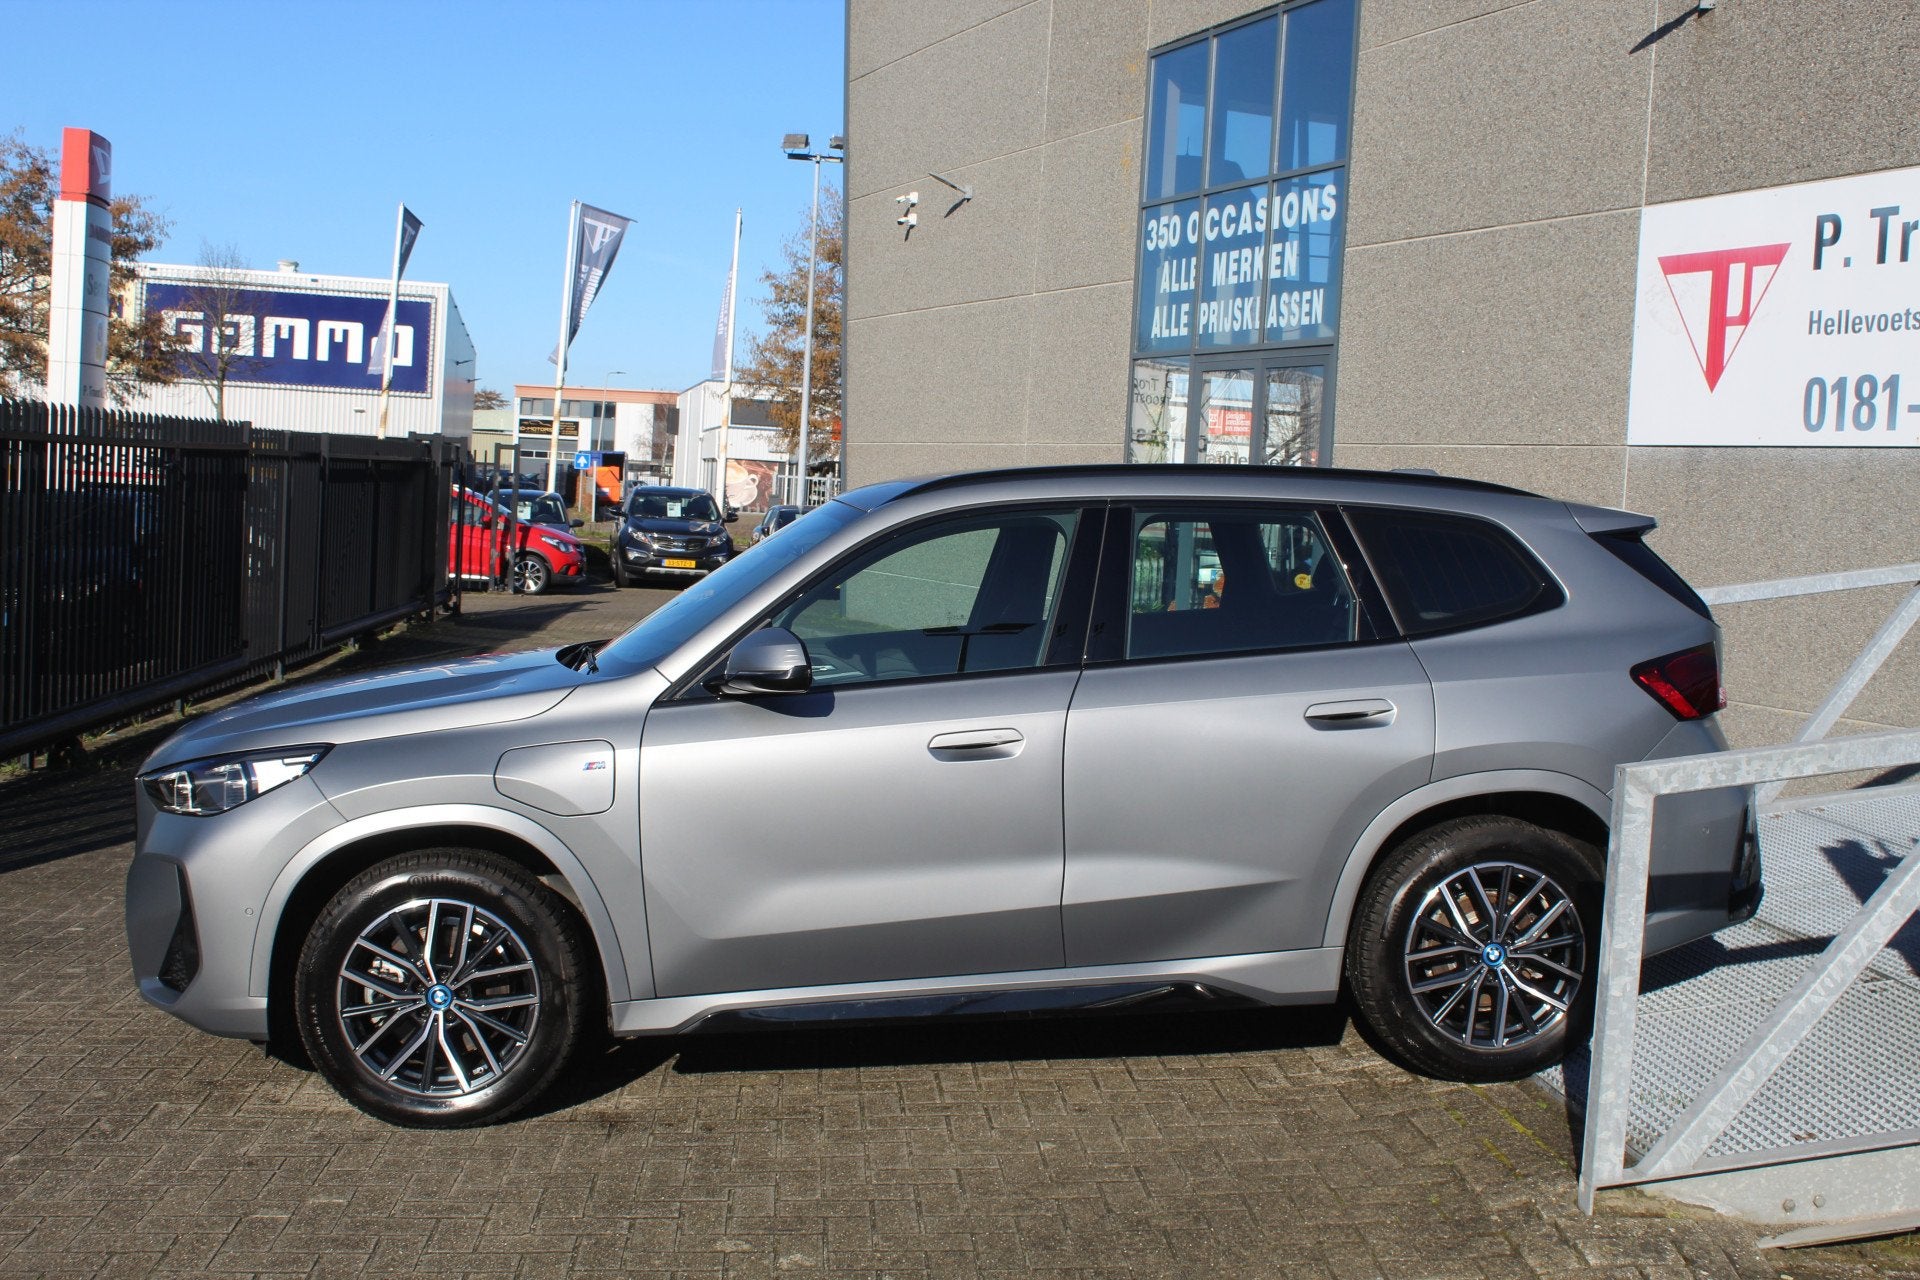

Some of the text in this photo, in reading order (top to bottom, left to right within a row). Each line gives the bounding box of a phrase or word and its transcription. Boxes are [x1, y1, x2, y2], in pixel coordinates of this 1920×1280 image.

[1146, 184, 1337, 251] 350 OCCASIONS
[1813, 206, 1919, 270] P. Tr
[1160, 240, 1299, 293] ALLE MERKEN
[1150, 289, 1324, 339] ALLE PRIJSKLASSEN
[1803, 373, 1920, 433] 0181-
